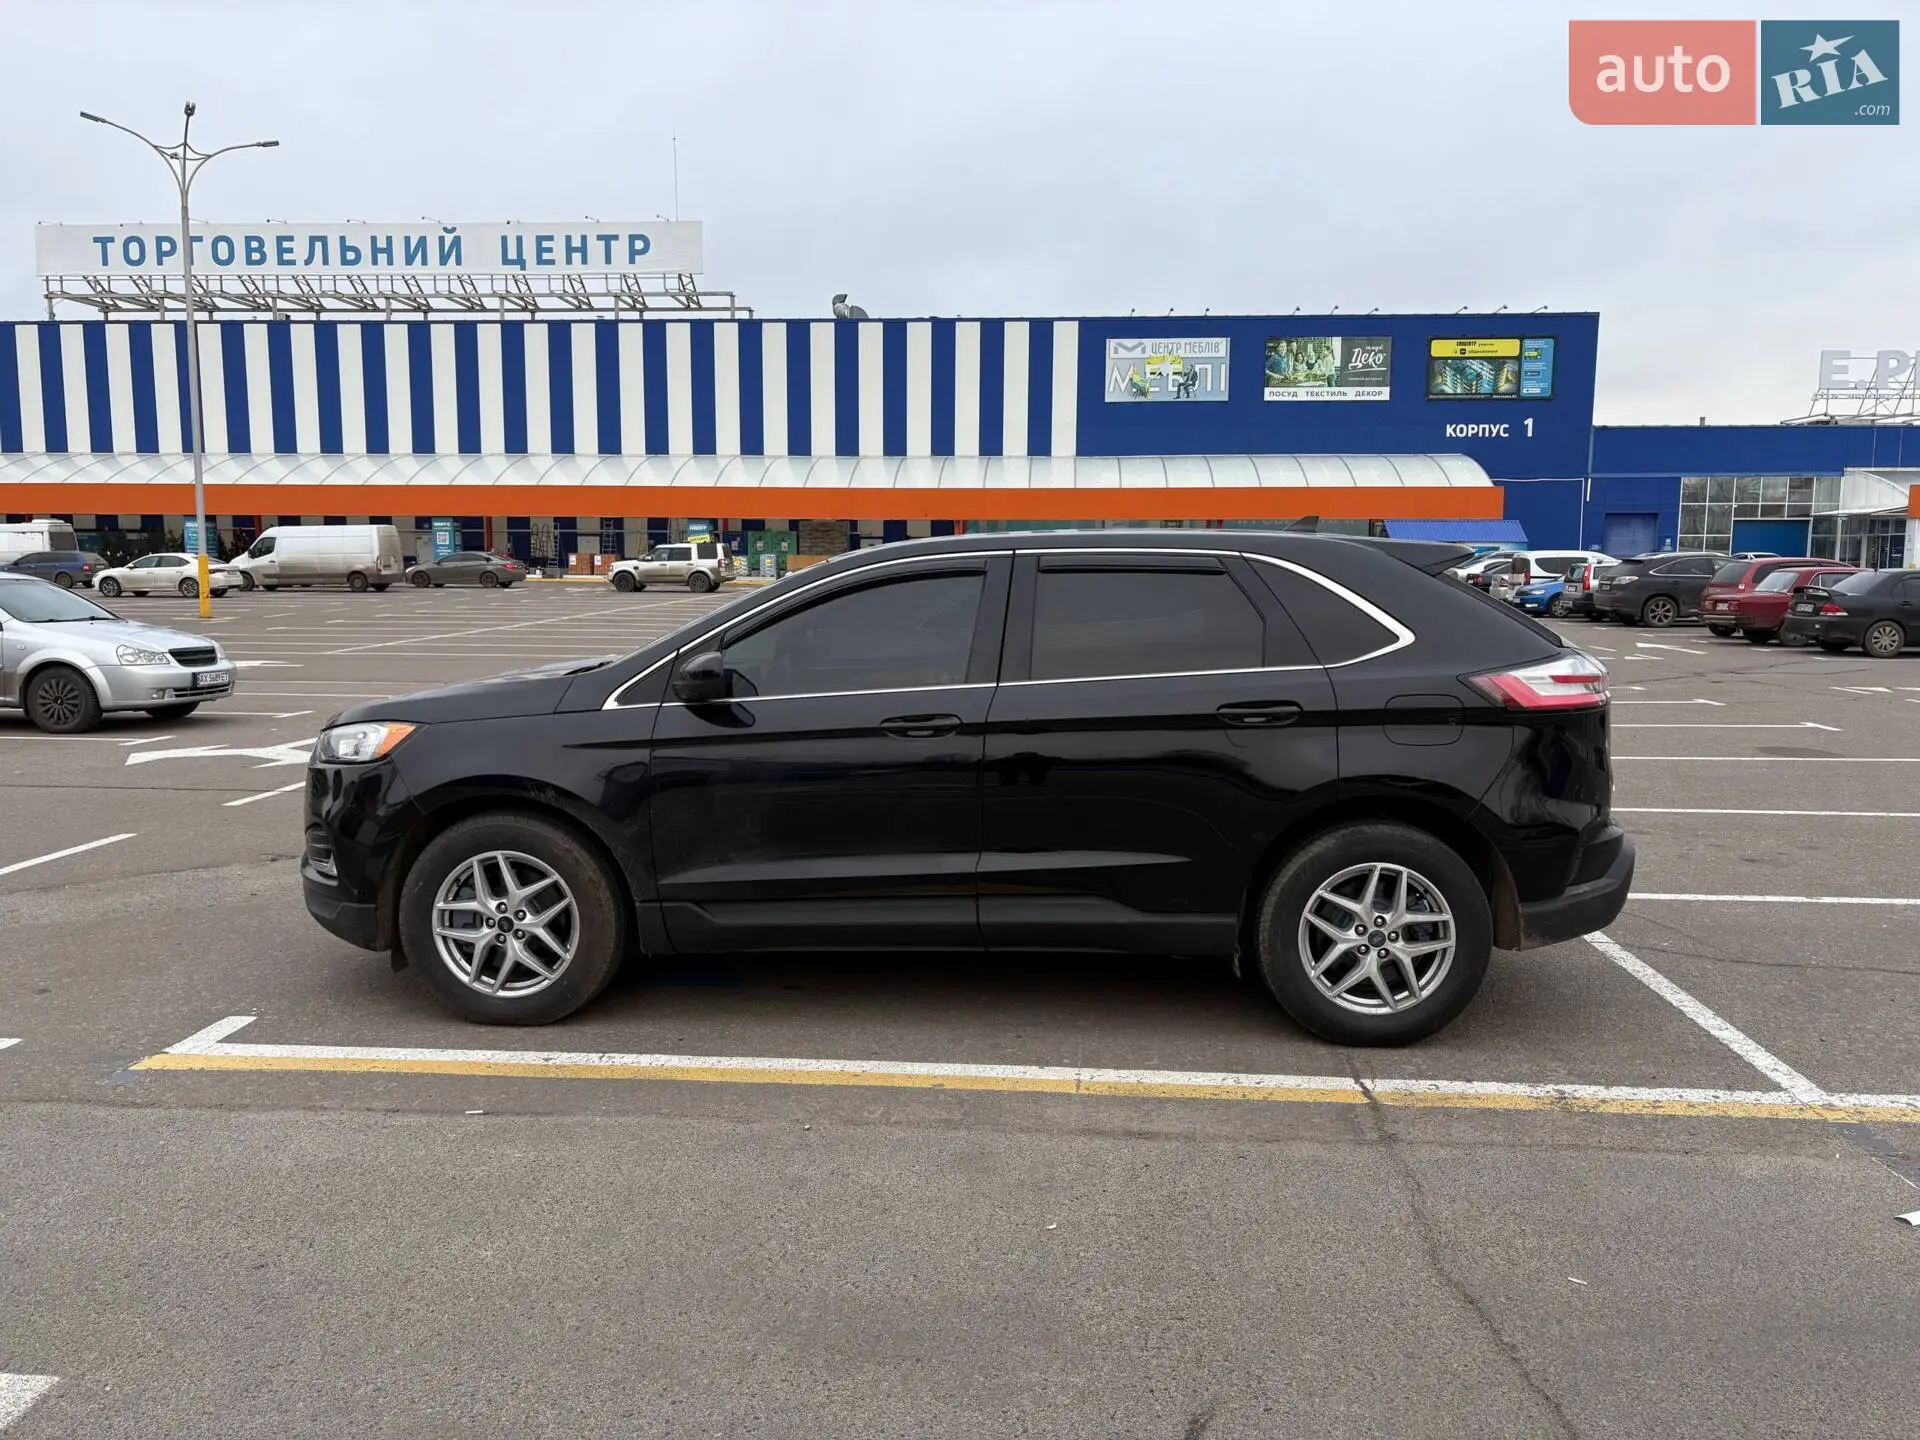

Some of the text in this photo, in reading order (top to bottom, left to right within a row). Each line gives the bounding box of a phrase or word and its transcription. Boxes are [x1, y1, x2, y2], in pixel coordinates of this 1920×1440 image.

[93, 226, 652, 271] ТОРГОВЕЛЬНИЙ ЦЕНТР
[1151, 341, 1182, 354] ЦЕНТР
[1819, 349, 1920, 390] E.P
[1269, 390, 1298, 398] ПОСУД
[1446, 417, 1534, 437] КОРПУС 1
